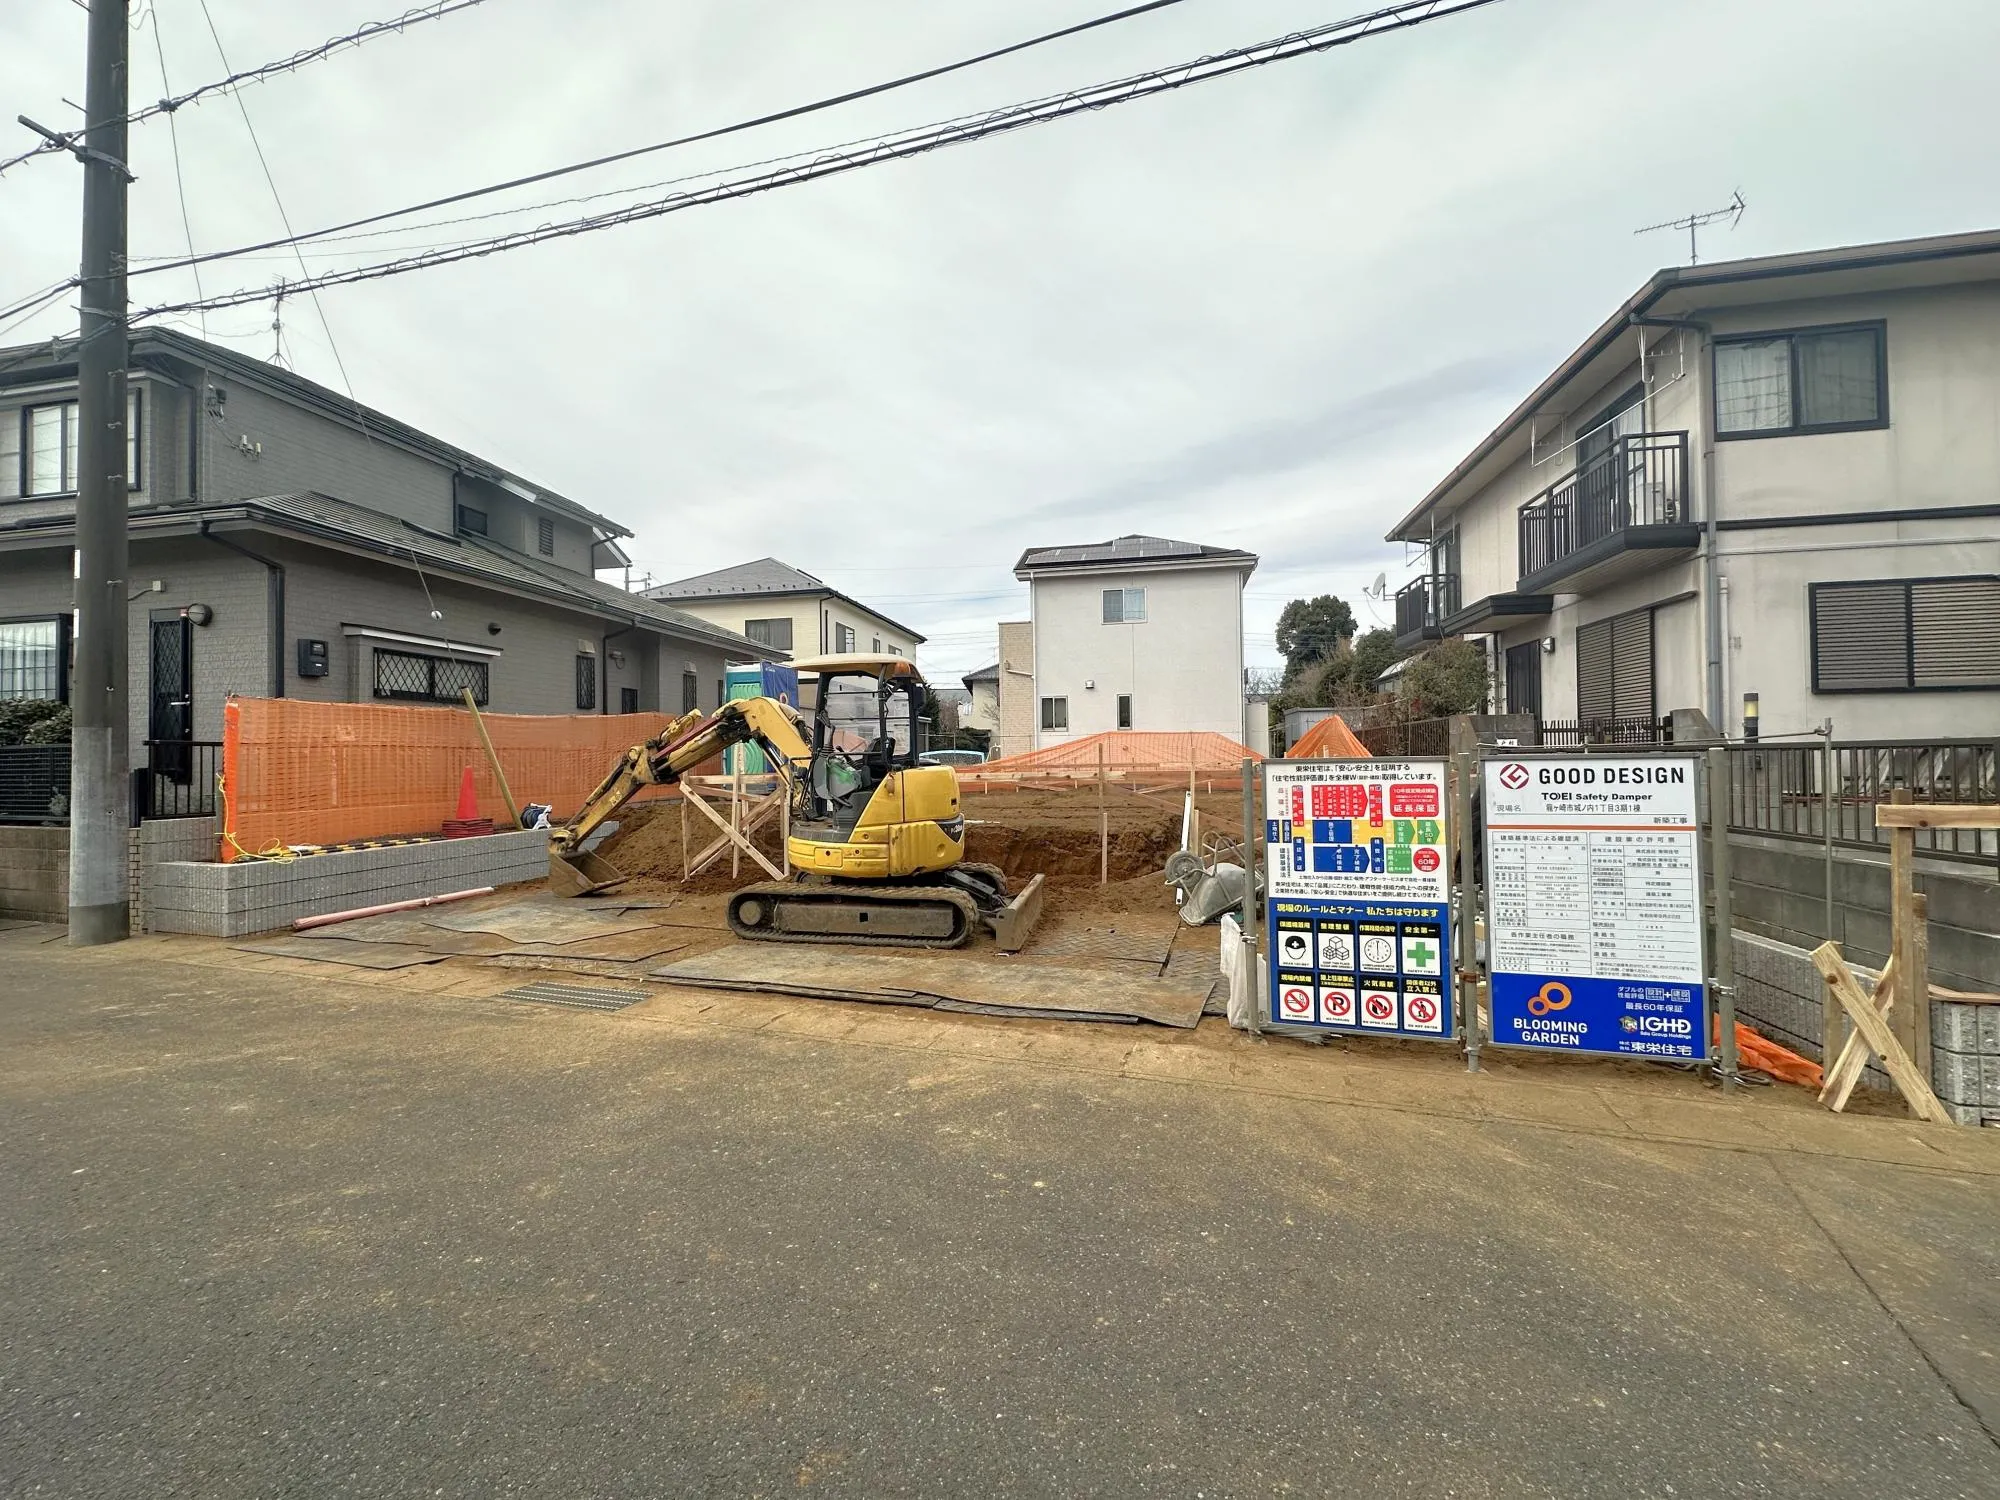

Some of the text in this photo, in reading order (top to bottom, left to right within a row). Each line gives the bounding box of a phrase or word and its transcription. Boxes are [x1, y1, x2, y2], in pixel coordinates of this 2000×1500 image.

[1538, 767, 1684, 784] GOOD DESIGN
[1575, 792, 1608, 802] Safety
[1611, 792, 1653, 802] Damper
[1496, 804, 1522, 813] 現場名
[1653, 816, 1688, 825] 新築工事
[1276, 903, 1439, 917] 現場のルールとマナー 私たちは守ります
[1625, 1002, 1683, 1013] 最長60年保証
[1513, 1018, 1588, 1034] BLOOMING
[1639, 1016, 1692, 1034] IGHD
[1521, 1031, 1580, 1046] GARDEN
[1630, 1041, 1692, 1056] 東栄住宅
